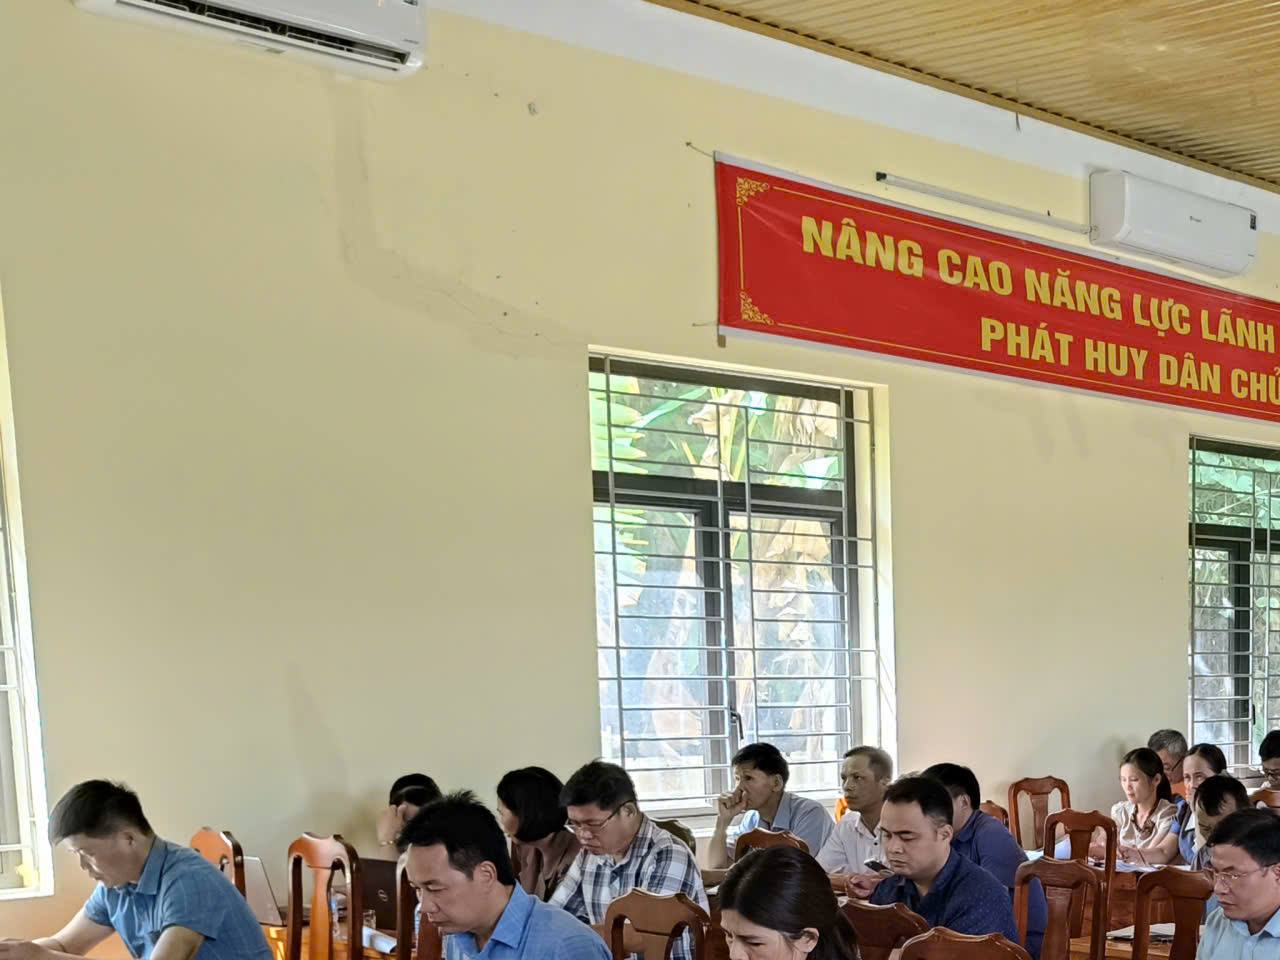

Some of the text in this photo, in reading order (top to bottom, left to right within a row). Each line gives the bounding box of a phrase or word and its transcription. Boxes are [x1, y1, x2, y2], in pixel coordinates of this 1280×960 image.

[801, 215, 924, 279] NÂNG
[938, 249, 1013, 296] CAO
[1025, 268, 1122, 321] NĂNG
[1133, 294, 1190, 337] LỰC
[1201, 308, 1275, 354] LÃNH
[981, 317, 1073, 366] PHÁT
[1085, 339, 1148, 381] HUY
[1160, 353, 1220, 395] DÂN
